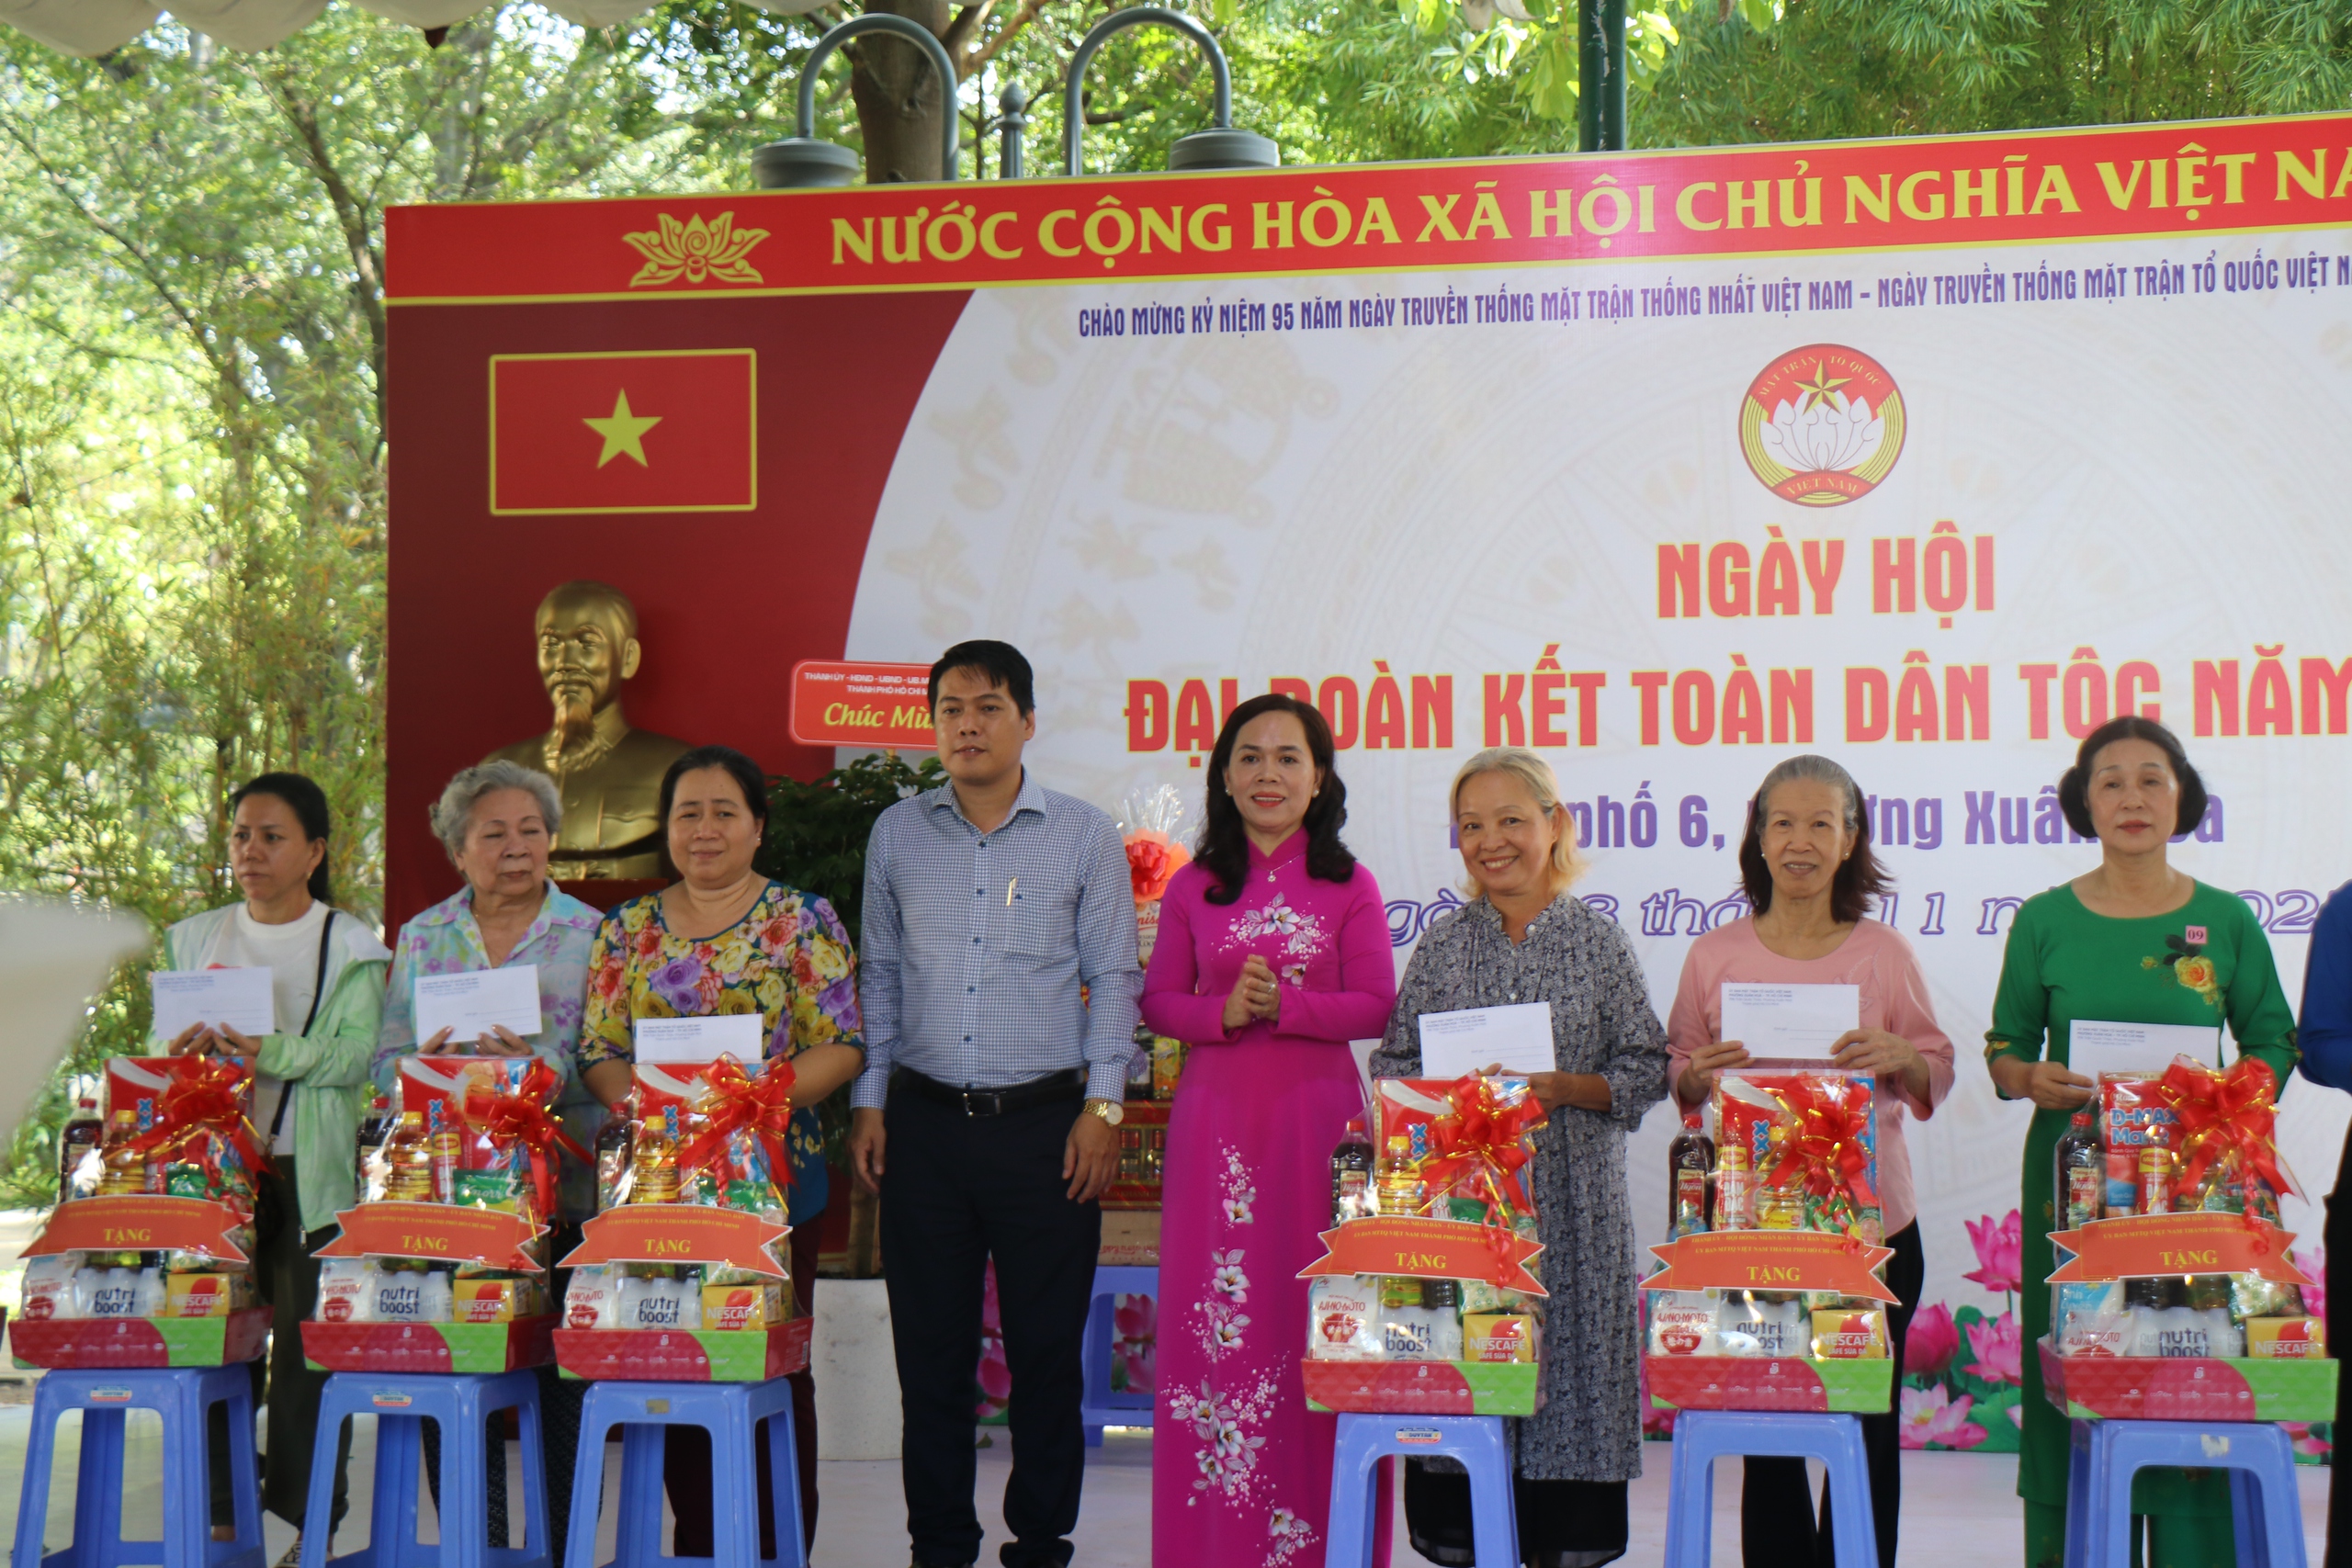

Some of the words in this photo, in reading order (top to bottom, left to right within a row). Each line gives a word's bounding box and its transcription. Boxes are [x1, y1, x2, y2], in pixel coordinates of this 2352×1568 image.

[831, 199, 1023, 265] NƯỚC
[1038, 194, 1233, 268] CỘNG
[1252, 186, 1402, 251] HÒA
[1417, 180, 1512, 242] XÃ
[1529, 173, 1657, 249] HỘI
[1676, 160, 1823, 231] CHỦ
[1844, 154, 2082, 224] NGHĨA
[2096, 142, 2256, 220] VIỆT
[1080, 302, 1125, 336] CHÀO
[1132, 300, 1185, 335] MỪNG
[1194, 296, 1214, 333] KỶ
[1220, 298, 1266, 337] NIỆM
[1272, 302, 1295, 331] 95
[1301, 296, 1342, 330] NĂM
[1350, 293, 1396, 329] NGÀY
[1401, 285, 1468, 326] TRUYỀN
[1475, 282, 1534, 324] THỐNG
[1541, 286, 1581, 326] MẶT
[1588, 284, 1634, 324] TRẬN
[1641, 276, 1702, 317] THỐNG
[1708, 273, 1756, 315] NHẤT
[1762, 276, 1802, 318] VIỆT
[1808, 279, 1852, 310] NAM
[1877, 271, 1928, 308] NGÀY
[1934, 262, 2006, 305] TRUYỀN
[2013, 260, 2075, 301] THỐNG
[2084, 263, 2127, 304] MẶT
[2134, 259, 2185, 301] TRẬN
[2192, 250, 2216, 293] TỔ
[2223, 248, 2278, 292] QUỐC
[2286, 251, 2329, 294] VIỆT
[1826, 477, 1858, 493] NAM
[1657, 525, 1845, 618] NGÀY
[1871, 521, 1995, 629] HỘI
[1483, 644, 1606, 748] KẾT
[1631, 654, 1815, 745] TOÀN
[1844, 650, 1990, 744] DÂN
[2192, 642, 2352, 738] NĂM
[824, 703, 885, 728] Chúc
[1640, 888, 1753, 936] thá
[2188, 929, 2204, 941] 09
[103, 1228, 151, 1245] TẶNG
[402, 1235, 448, 1252] TẶNG
[645, 1236, 691, 1256] TẶNG
[1395, 1251, 1447, 1270] TẶNG
[2159, 1249, 2219, 1269] TẶNG
[1747, 1264, 1801, 1284] TẶNG
[95, 1288, 135, 1300] nutri
[380, 1285, 420, 1302] nutri
[95, 1301, 135, 1314] boost
[379, 1301, 420, 1314] boost
[639, 1296, 680, 1310] nutri
[639, 1310, 680, 1324] boost
[2160, 1327, 2207, 1344] nutri
